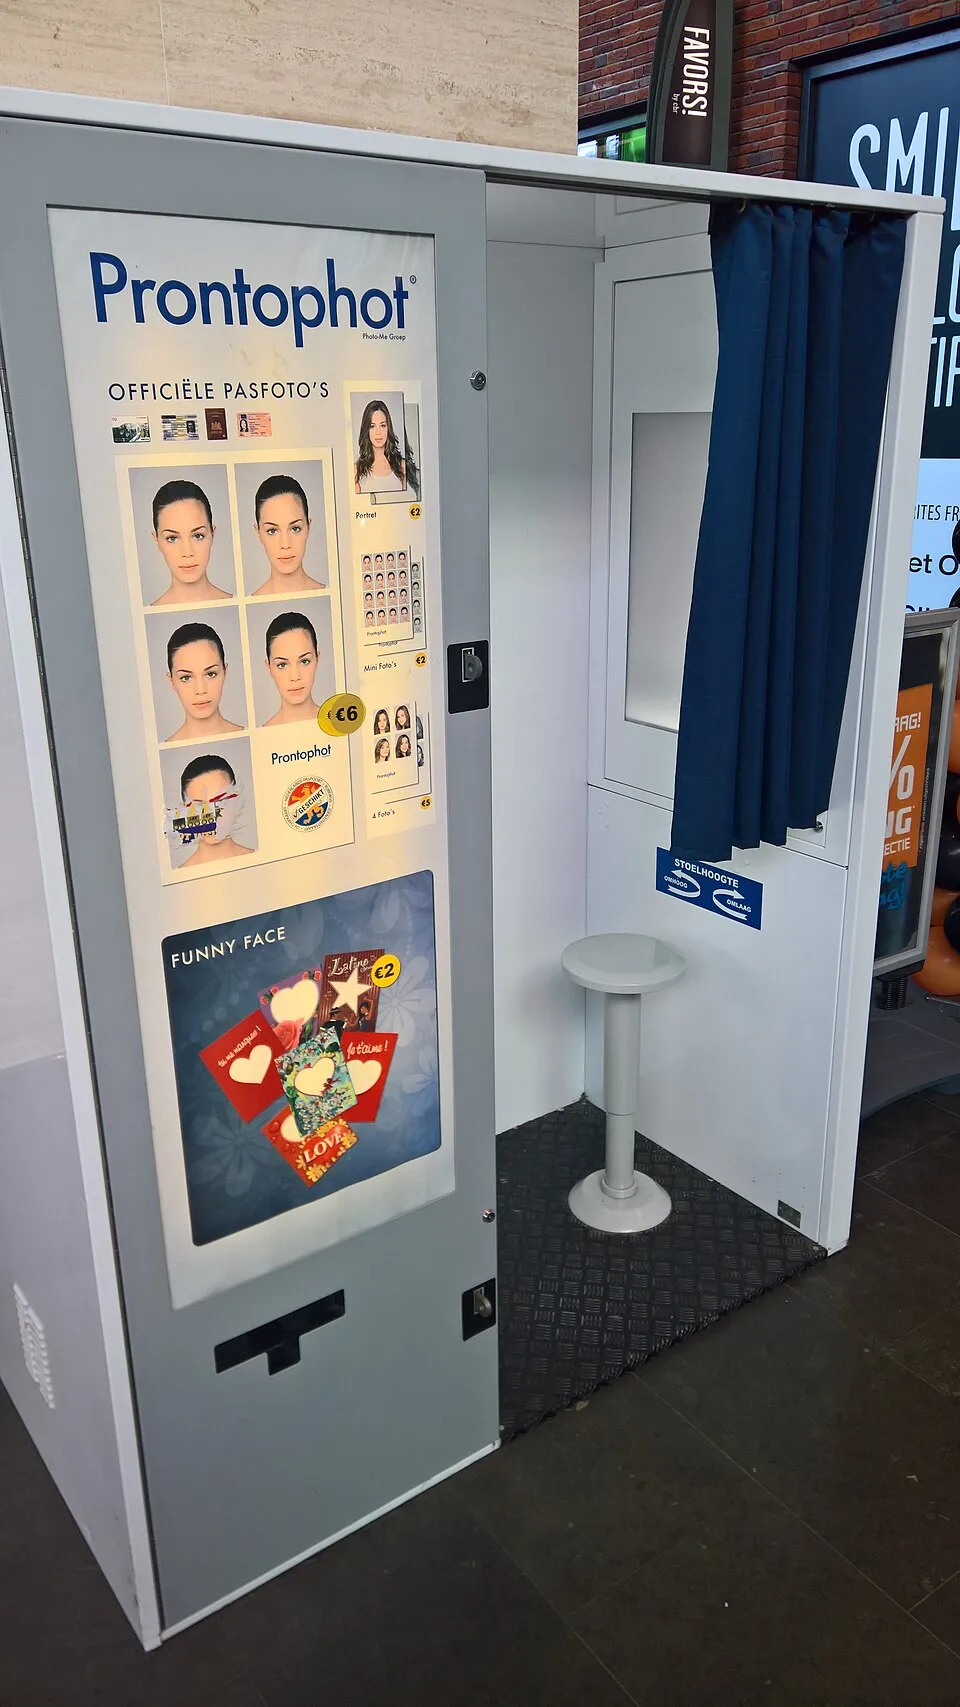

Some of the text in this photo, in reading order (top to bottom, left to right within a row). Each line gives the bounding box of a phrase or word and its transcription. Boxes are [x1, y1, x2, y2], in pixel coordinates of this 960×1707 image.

[682, 26, 710, 117] FAVORS!
[672, 93, 680, 101] by
[89, 251, 409, 348] Prontophot
[362, 332, 388, 340] Photo-Me
[108, 378, 330, 401] OFFICIËLE PASFOTO'S
[355, 511, 377, 520] Portret
[410, 507, 421, 517] €2
[914, 504, 942, 521] ITES
[363, 660, 397, 672] Mini Foto's
[415, 655, 426, 665] €2
[335, 705, 358, 721] €6
[271, 744, 332, 765] Prontophot
[298, 789, 326, 814] GESCHIKT
[421, 798, 431, 807] €5
[377, 809, 396, 818] Foto's
[674, 858, 739, 888] STOELHOOGTE
[664, 875, 688, 889] OMHOOG
[726, 898, 752, 913] OMLAAG
[171, 926, 286, 969] FUNNY FACE
[328, 956, 369, 977] Latino
[374, 962, 395, 979] €2
[303, 1131, 342, 1163] LOVE
